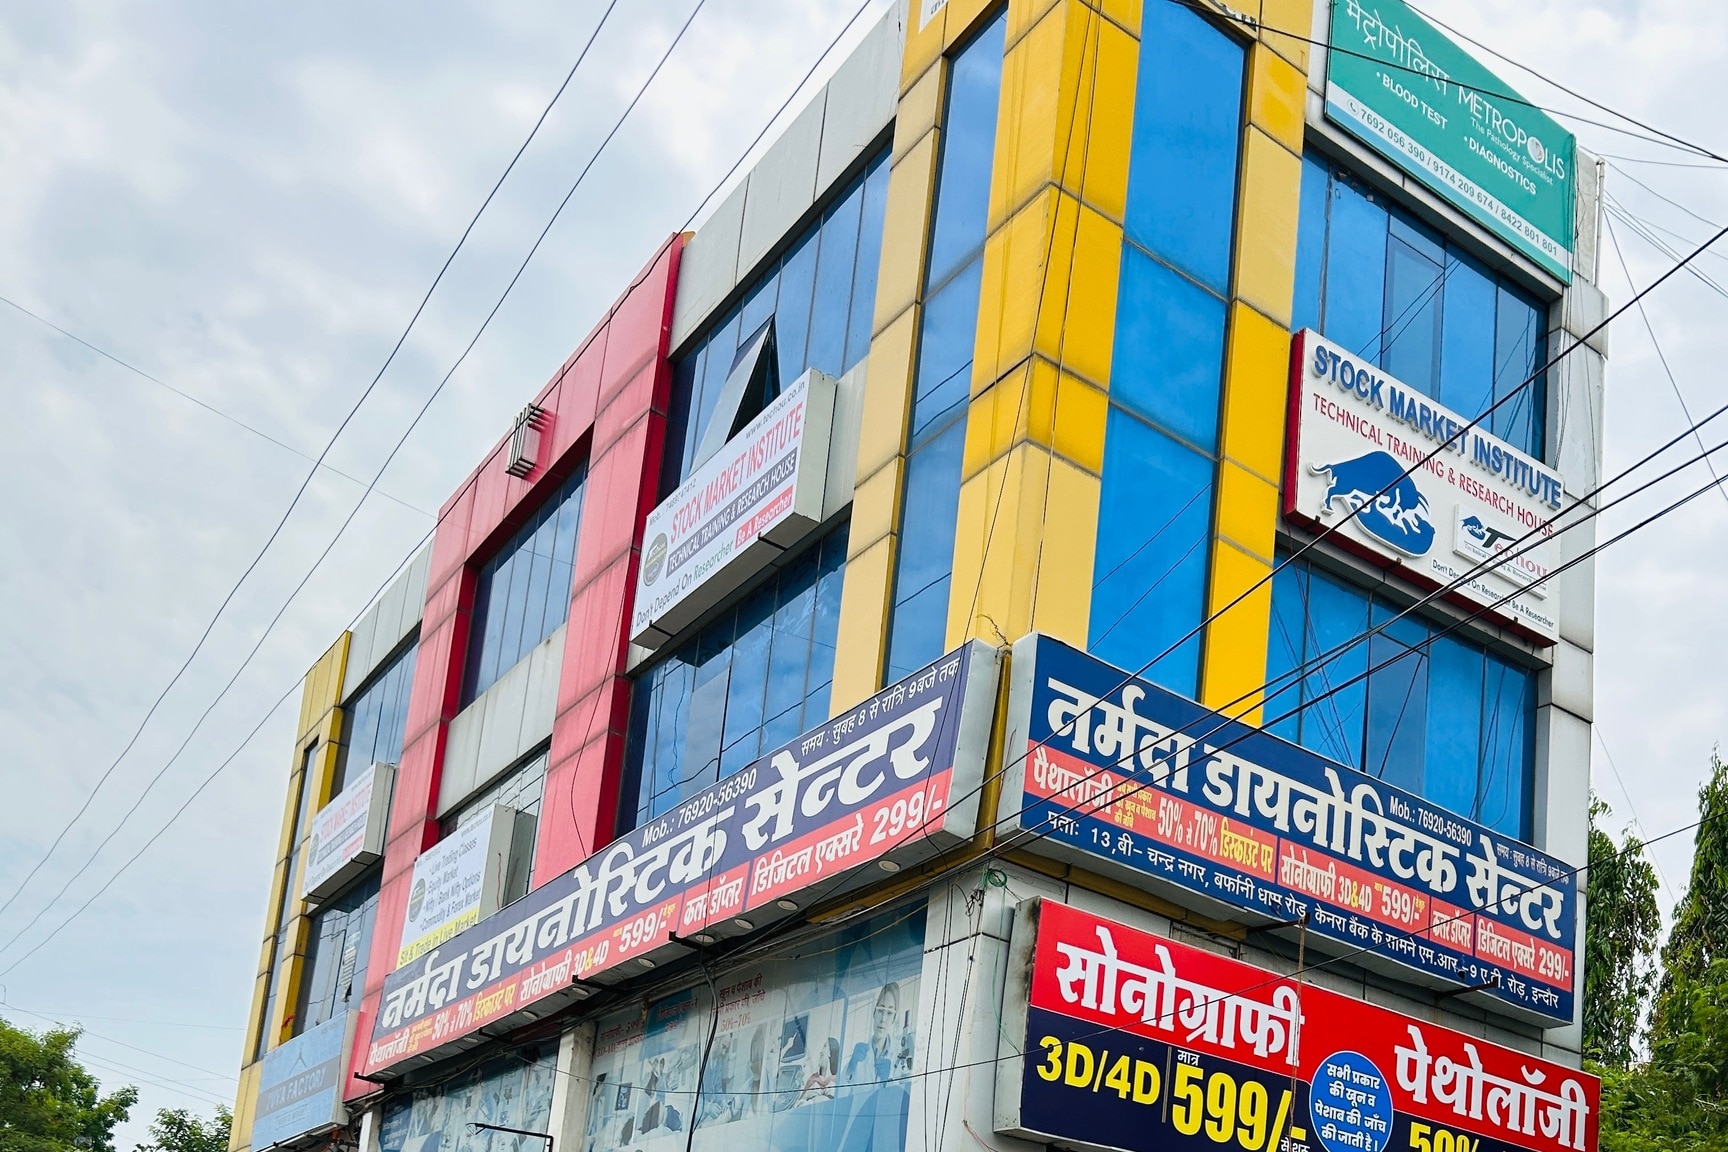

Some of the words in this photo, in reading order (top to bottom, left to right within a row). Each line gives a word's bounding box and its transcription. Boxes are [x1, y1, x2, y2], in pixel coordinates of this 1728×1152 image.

[1382, 73, 1419, 109] BLOOD
[1420, 102, 1448, 129] TEST
[1458, 86, 1565, 180] METROPOLIS
[1360, 108, 1385, 134] 7692
[1387, 126, 1406, 147] 056
[1407, 142, 1425, 163] 390
[1433, 162, 1456, 184] 9174
[1457, 179, 1475, 198] 209
[1476, 192, 1494, 211] 674
[1501, 208, 1522, 231] 8422
[1524, 225, 1540, 245] 801
[1542, 237, 1558, 256] 801
[1469, 137, 1537, 195] DIAGNOSTICS
[670, 488, 702, 544] STOCK
[703, 454, 747, 515] MARKET
[747, 401, 804, 479] INSTITUTE
[1314, 344, 1384, 408] STOCK
[1389, 386, 1469, 452] MARKET
[1473, 433, 1562, 509] INSTITUTE
[1314, 393, 1383, 446] TECHNICAL
[1386, 432, 1444, 479] TRAINING
[1448, 467, 1456, 485] &
[1459, 472, 1514, 519] RESEARCH
[1517, 506, 1554, 538] HOUSE
[668, 533, 700, 571] TECHNICAL
[700, 511, 730, 549] TRAINING
[737, 479, 770, 514] RESEARCH
[770, 453, 796, 491] HOUSE
[832, 716, 856, 745] सुबह
[858, 710, 867, 726] 8
[868, 699, 880, 722] से
[939, 656, 961, 683] तक
[641, 820, 673, 848] Mob.:
[677, 768, 758, 828] 76920-56390
[1047, 677, 1196, 794] नर्मदा
[1202, 744, 1459, 893] डायनोस्टिक
[1466, 834, 1564, 939] सेन्टर
[1389, 796, 1415, 823] Mob.:
[1418, 807, 1472, 847] 76920-56390
[382, 950, 467, 1029] नर्मदा
[466, 806, 735, 991] डायनोस्टिक
[741, 696, 944, 851] सेन्टर
[572, 939, 610, 976] 3D&4D
[619, 906, 667, 954] 599/-
[751, 849, 812, 897] डिजिटल
[814, 813, 865, 874] एक्सरे
[869, 784, 943, 845] 299/-
[1157, 797, 1184, 844] 50%
[1193, 810, 1219, 857] 70%
[1260, 842, 1273, 874] पर
[1280, 845, 1337, 904] सोनोग्राफी
[1338, 869, 1372, 914] 3D&4D
[1381, 885, 1420, 926] 599/-
[1477, 916, 1511, 963] डिजिटल
[1511, 937, 1536, 972] एक्सरे
[1538, 947, 1570, 983] 299/-
[1147, 848, 1174, 873] चन्द्र
[1214, 870, 1255, 900] बर्फानी
[1315, 902, 1346, 935] केनरा
[1349, 914, 1369, 942] बैंक
[1371, 923, 1382, 945] के
[1385, 931, 1416, 958] सामने
[1531, 987, 1560, 1009] इन्दौर
[1037, 1035, 1161, 1105] 3D/4D
[1056, 925, 1305, 1067] सोनोग्राफी
[1394, 1024, 1590, 1152] पेथोलॉजी
[1177, 1049, 1201, 1067] मात्र
[1327, 1063, 1351, 1082] सभी
[1352, 1069, 1381, 1090] प्रकार
[1315, 1099, 1345, 1123] पेशाब
[1346, 1108, 1361, 1127] की
[1364, 1113, 1387, 1134] जाँच
[1321, 1123, 1337, 1141] की
[1338, 1129, 1364, 1149] जाती
[1329, 1080, 1344, 1098] की
[1346, 1087, 1367, 1108] खून
[1367, 1094, 1376, 1108] व
